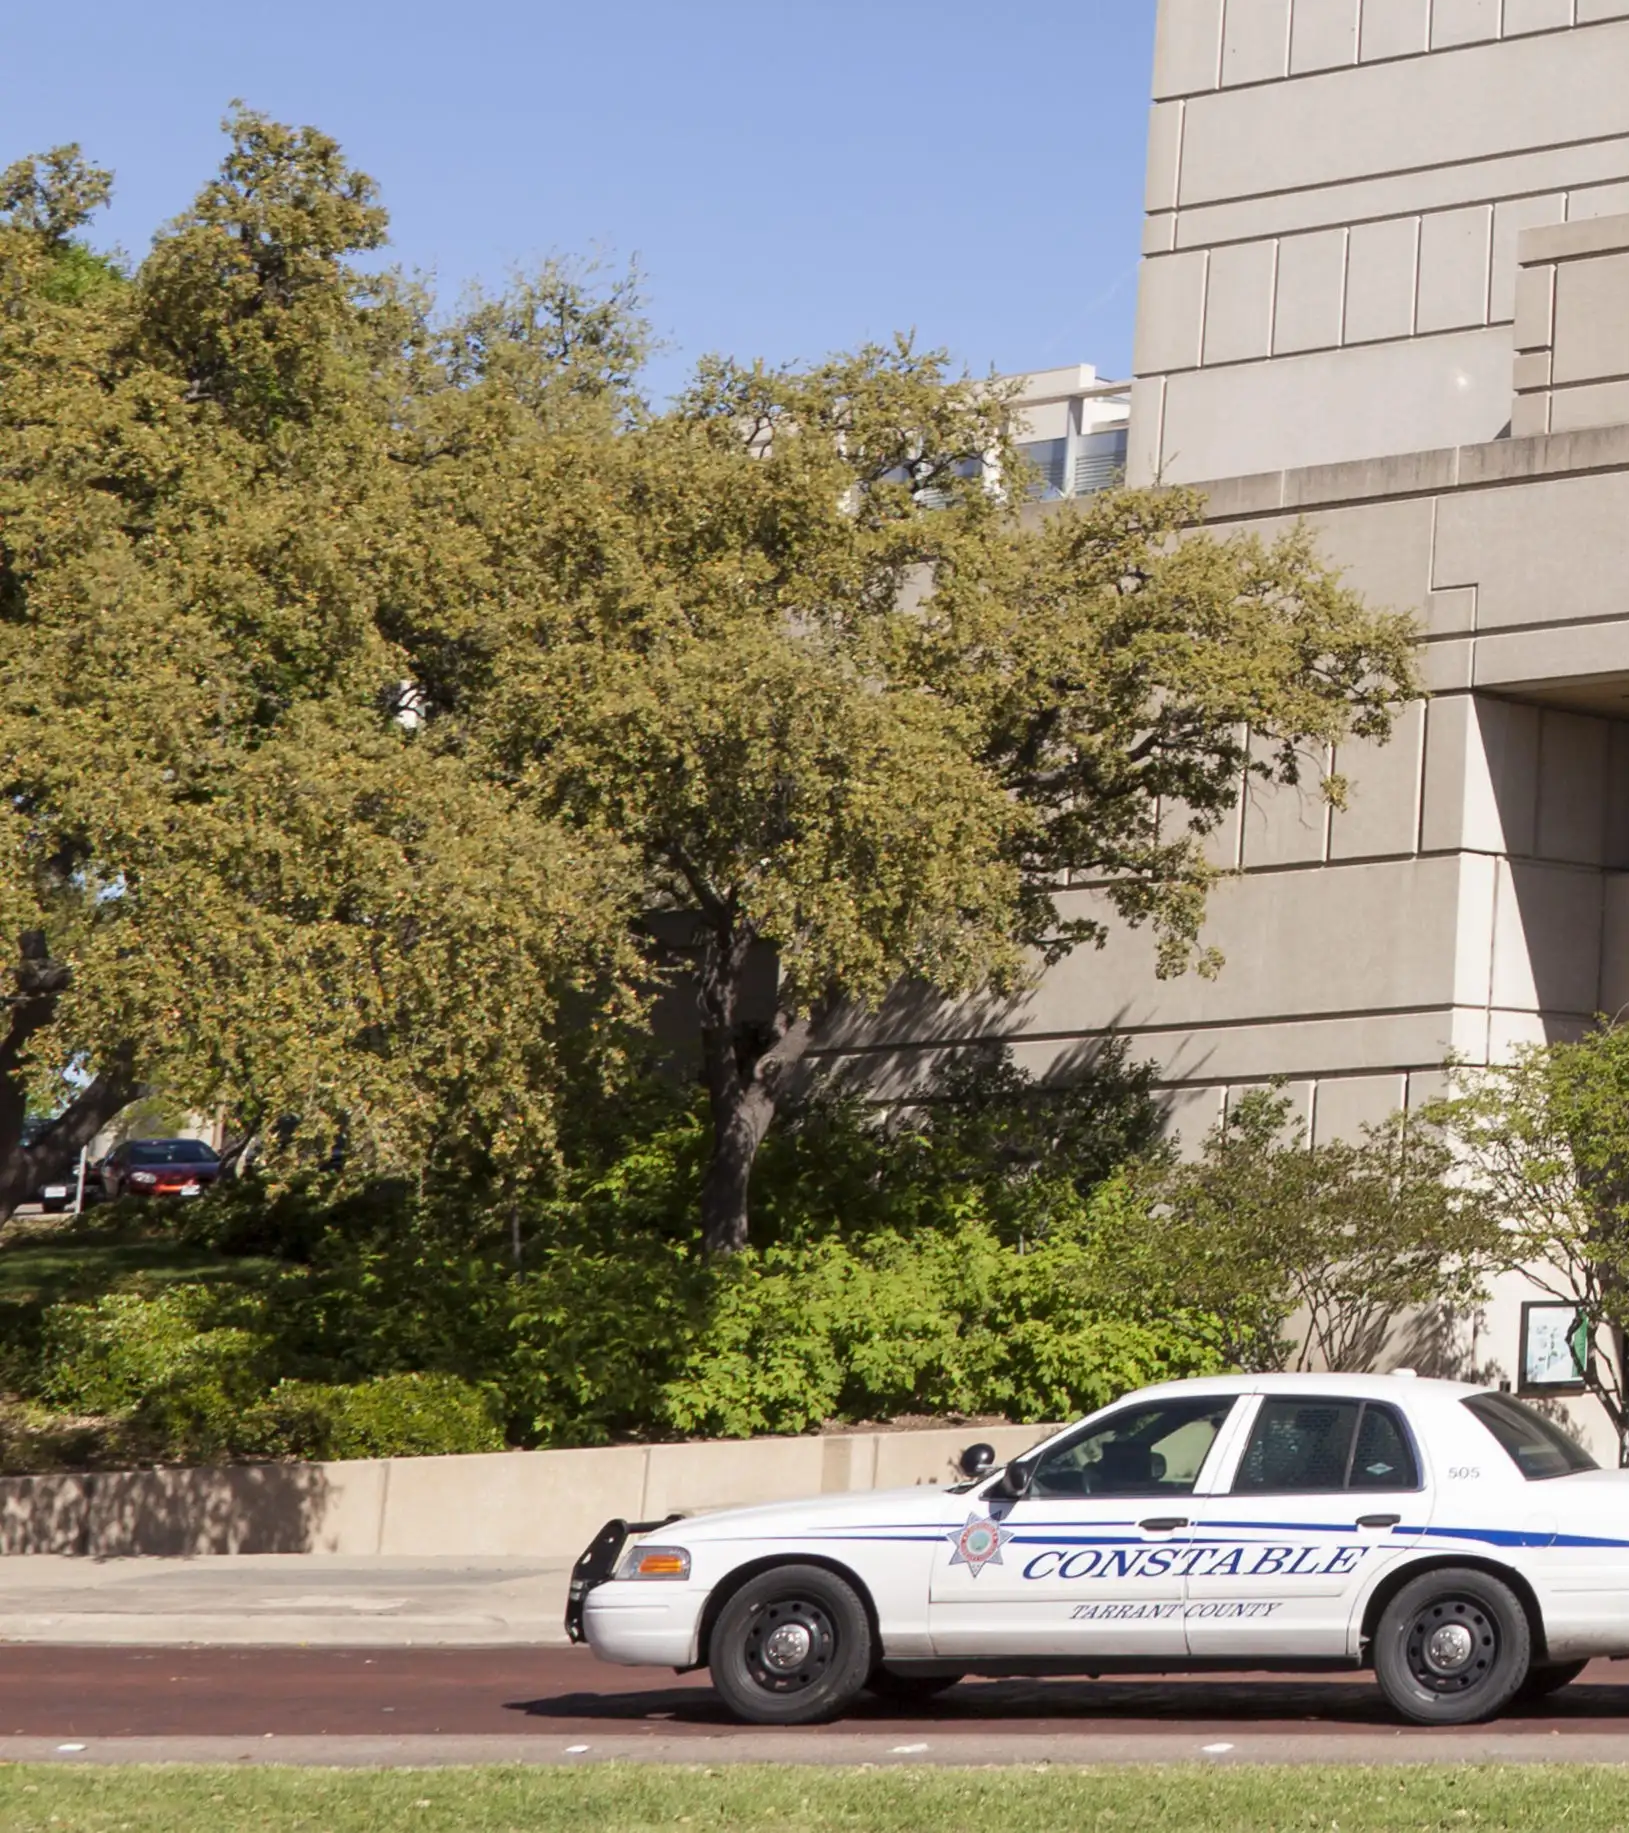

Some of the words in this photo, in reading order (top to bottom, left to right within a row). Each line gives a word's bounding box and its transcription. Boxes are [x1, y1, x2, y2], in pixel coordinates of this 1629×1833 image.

[1447, 1464, 1481, 1480] 505
[1022, 1547, 1367, 1579] CONSTABLE
[1069, 1604, 1186, 1620] TARRANT
[1184, 1603, 1282, 1619] COUNTY
